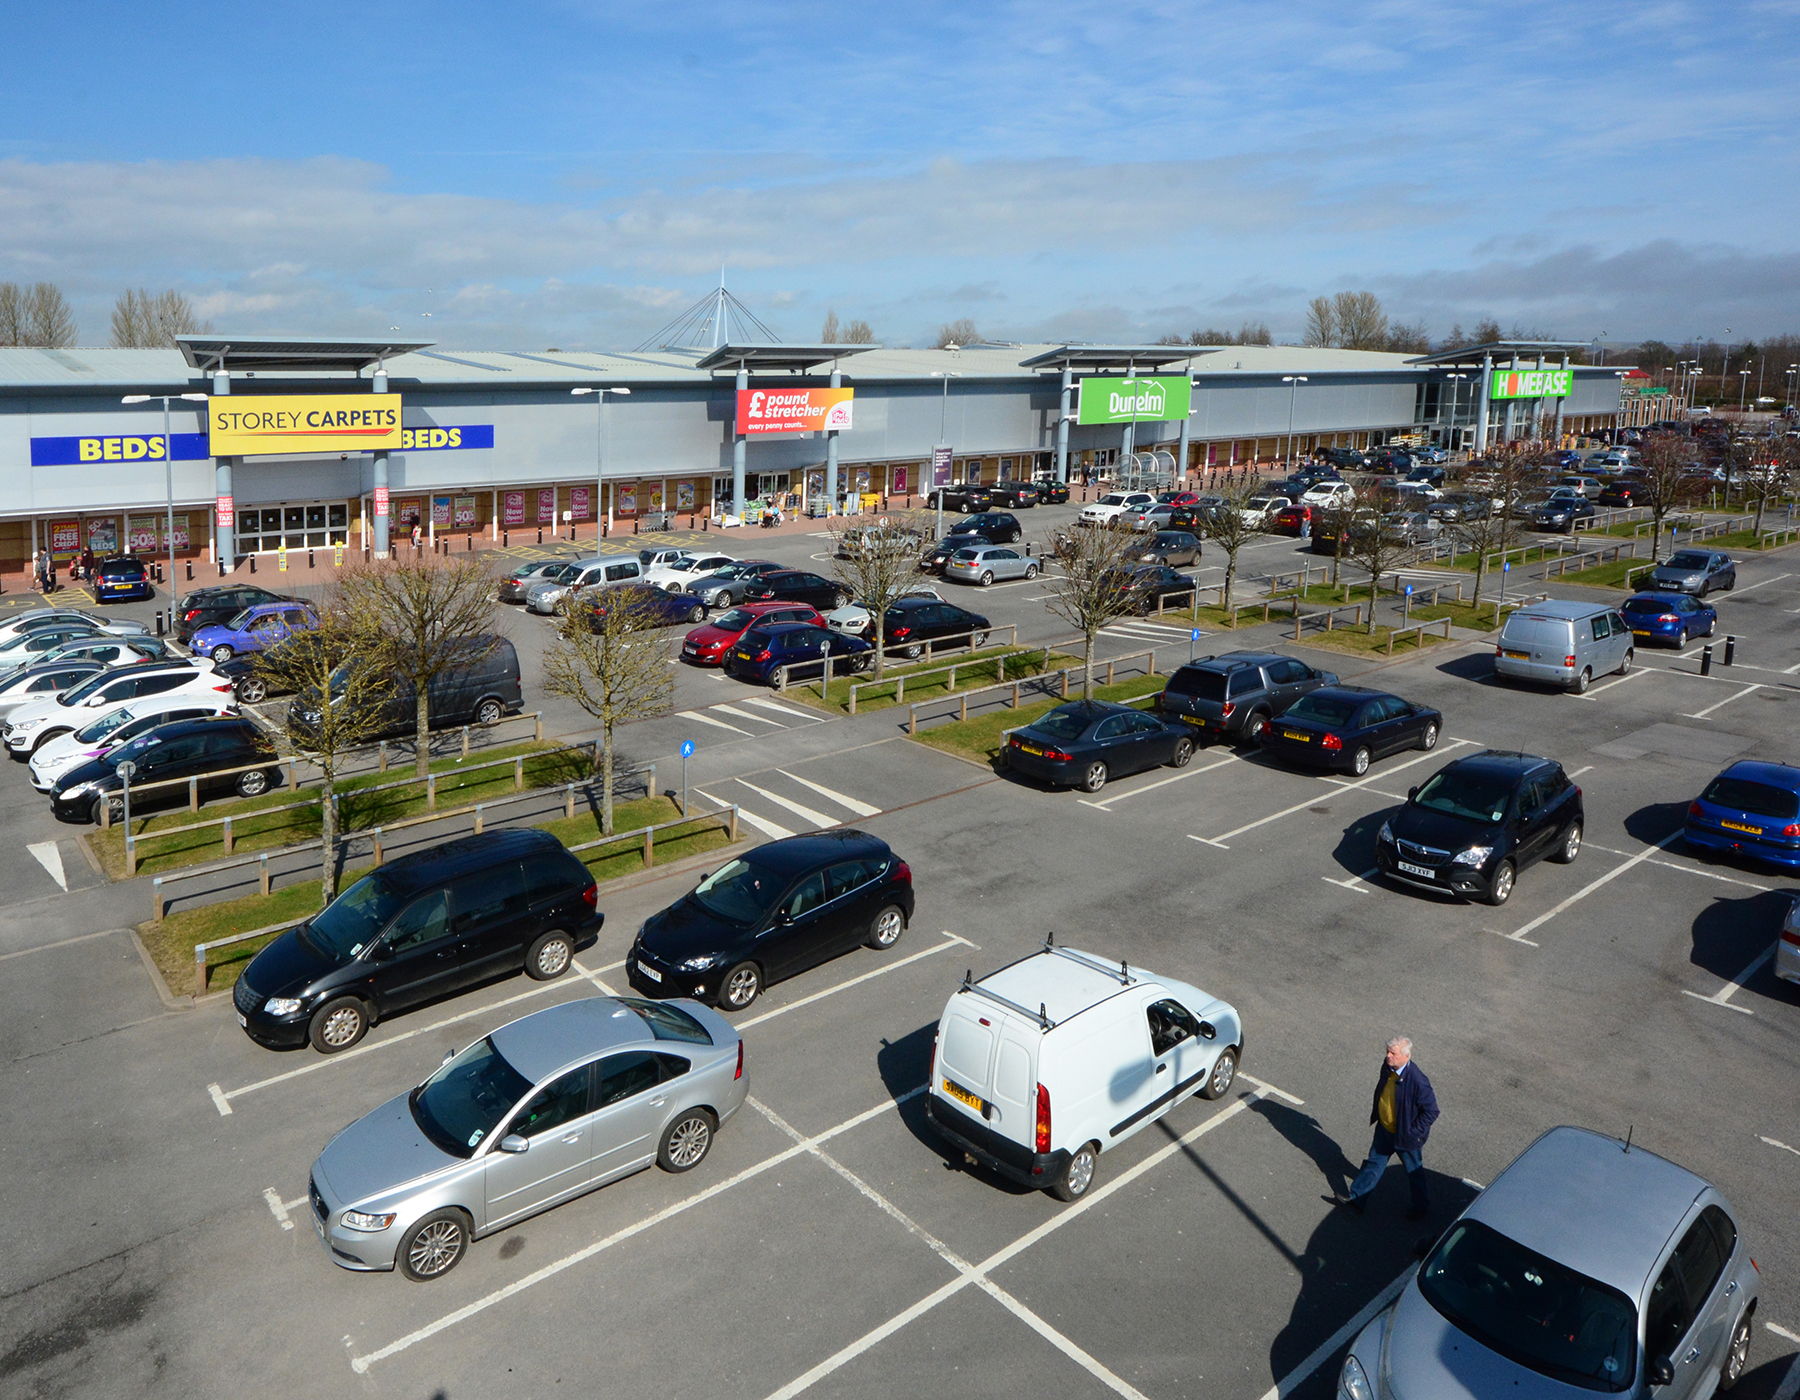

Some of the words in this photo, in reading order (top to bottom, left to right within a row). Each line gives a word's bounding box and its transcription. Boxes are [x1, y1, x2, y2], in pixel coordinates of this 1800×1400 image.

[1497, 372, 1568, 396] HOMEBASE
[766, 392, 810, 409] pound
[1109, 391, 1162, 413] Dunelm
[764, 405, 826, 418] stretcher
[217, 411, 302, 431] STOREY
[306, 409, 396, 428] CARPETS
[765, 423, 783, 431] penny
[402, 428, 462, 449] BEDS
[79, 436, 165, 461] BEDS
[53, 525, 60, 533] 2
[53, 532, 79, 541] FREE
[91, 542, 115, 551] BEDS
[130, 533, 157, 547] 50%
